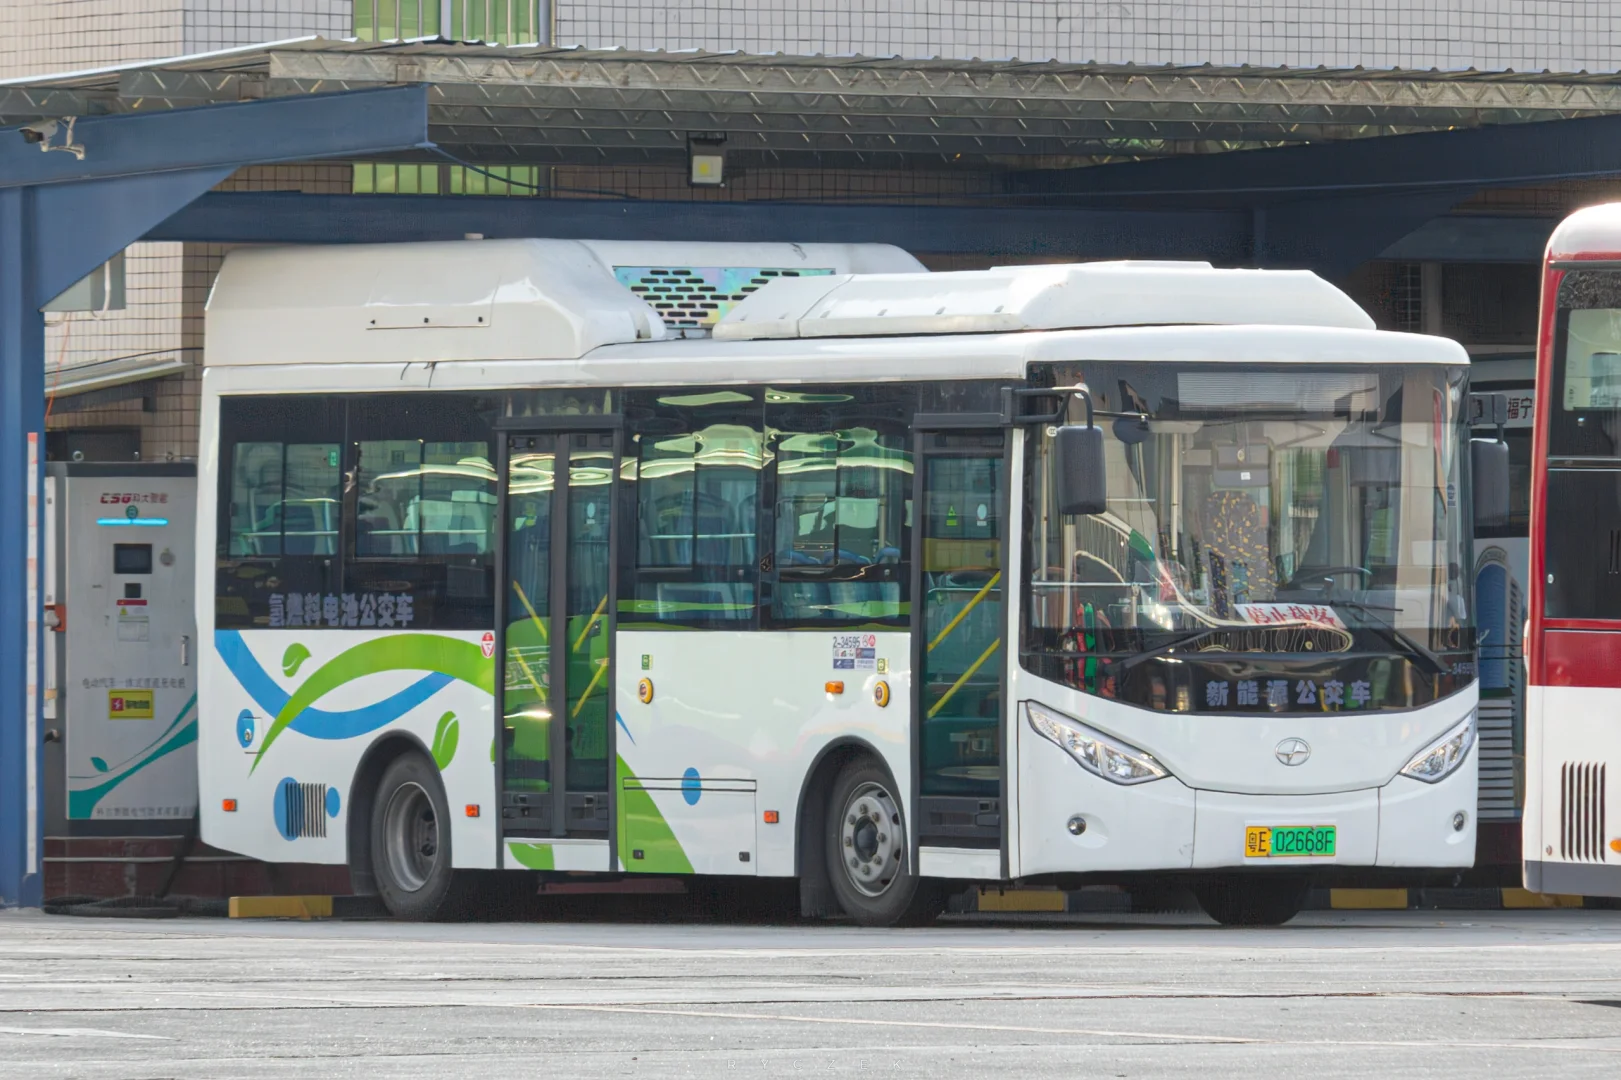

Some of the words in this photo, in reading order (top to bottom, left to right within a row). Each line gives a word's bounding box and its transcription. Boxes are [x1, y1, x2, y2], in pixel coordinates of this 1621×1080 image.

[1507, 397, 1534, 419] 福宁
[100, 492, 132, 504] CSG
[268, 593, 414, 627] 氢燃料电池公交车
[832, 636, 861, 648] 2-34595
[1205, 680, 1371, 707] 新能源公交车
